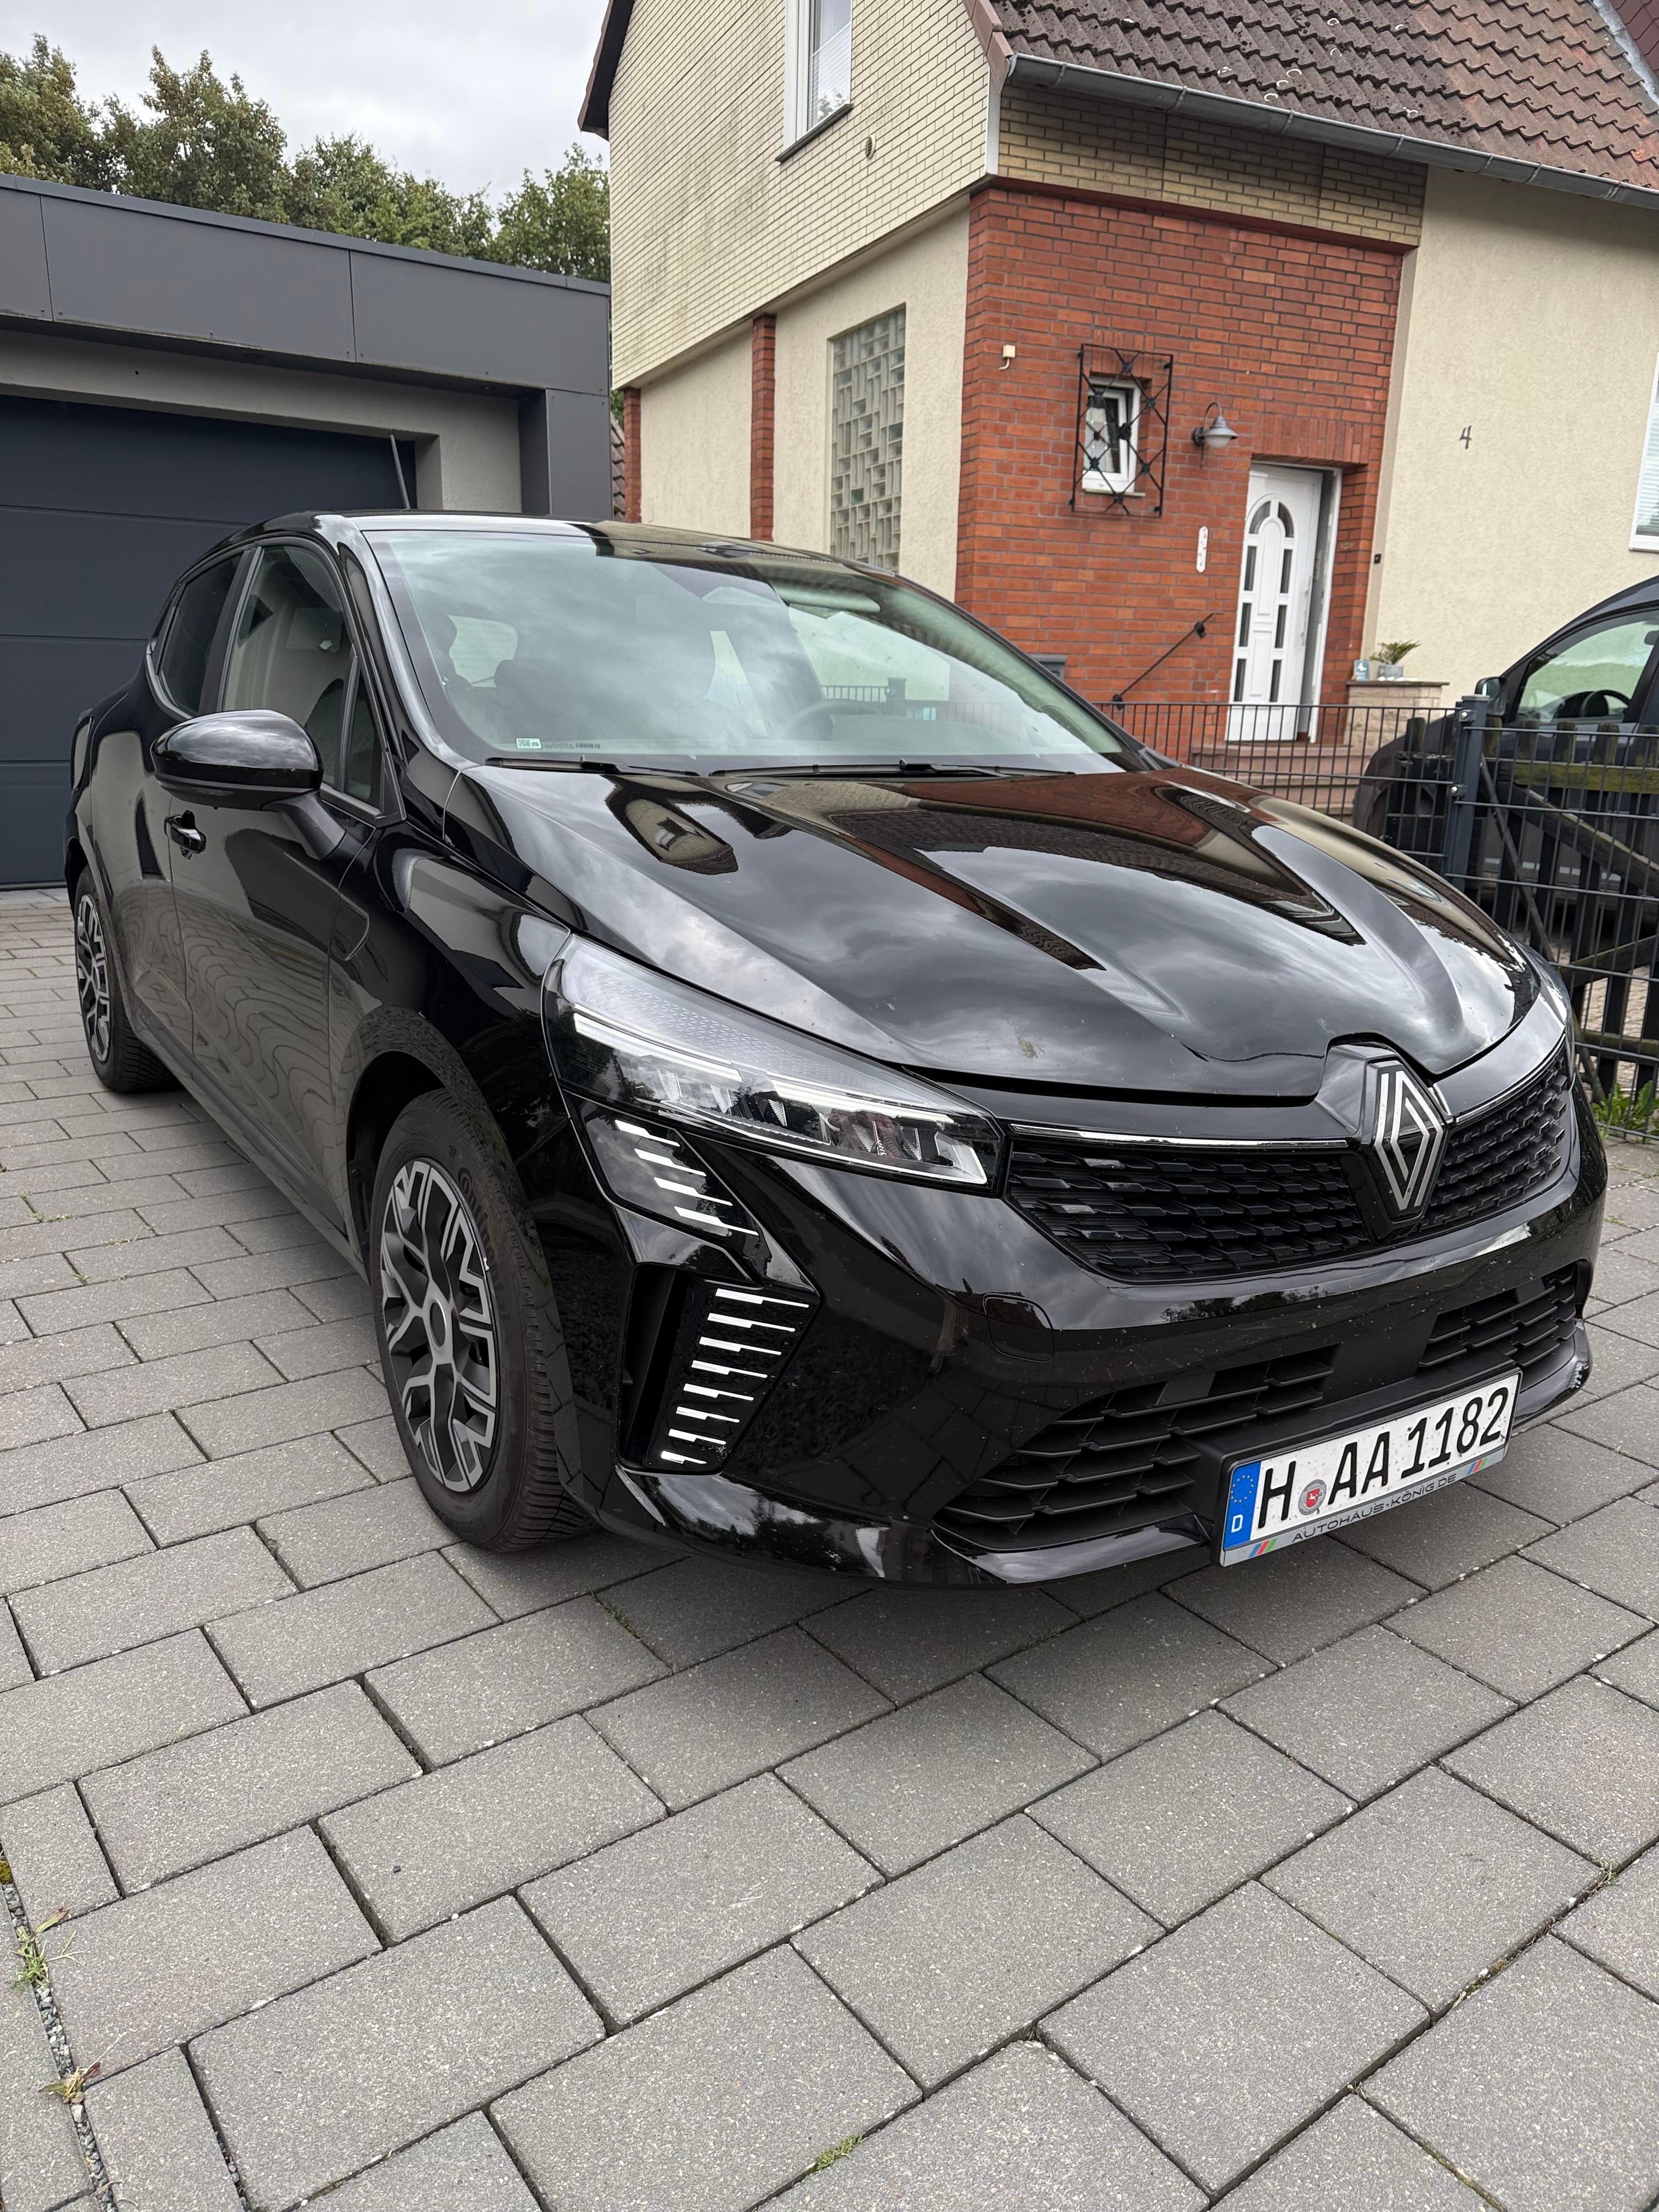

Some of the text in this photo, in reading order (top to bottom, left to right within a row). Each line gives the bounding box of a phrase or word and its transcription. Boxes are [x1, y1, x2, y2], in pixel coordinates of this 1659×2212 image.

[1459, 425, 1472, 449] 4
[1257, 1460, 1296, 1530] H
[1328, 1431, 1390, 1505] AA
[1401, 1387, 1509, 1479] 1182
[1231, 1514, 1244, 1533] D
[1291, 1473, 1457, 1543] AUTOHAUS-KÖNIG.DE
